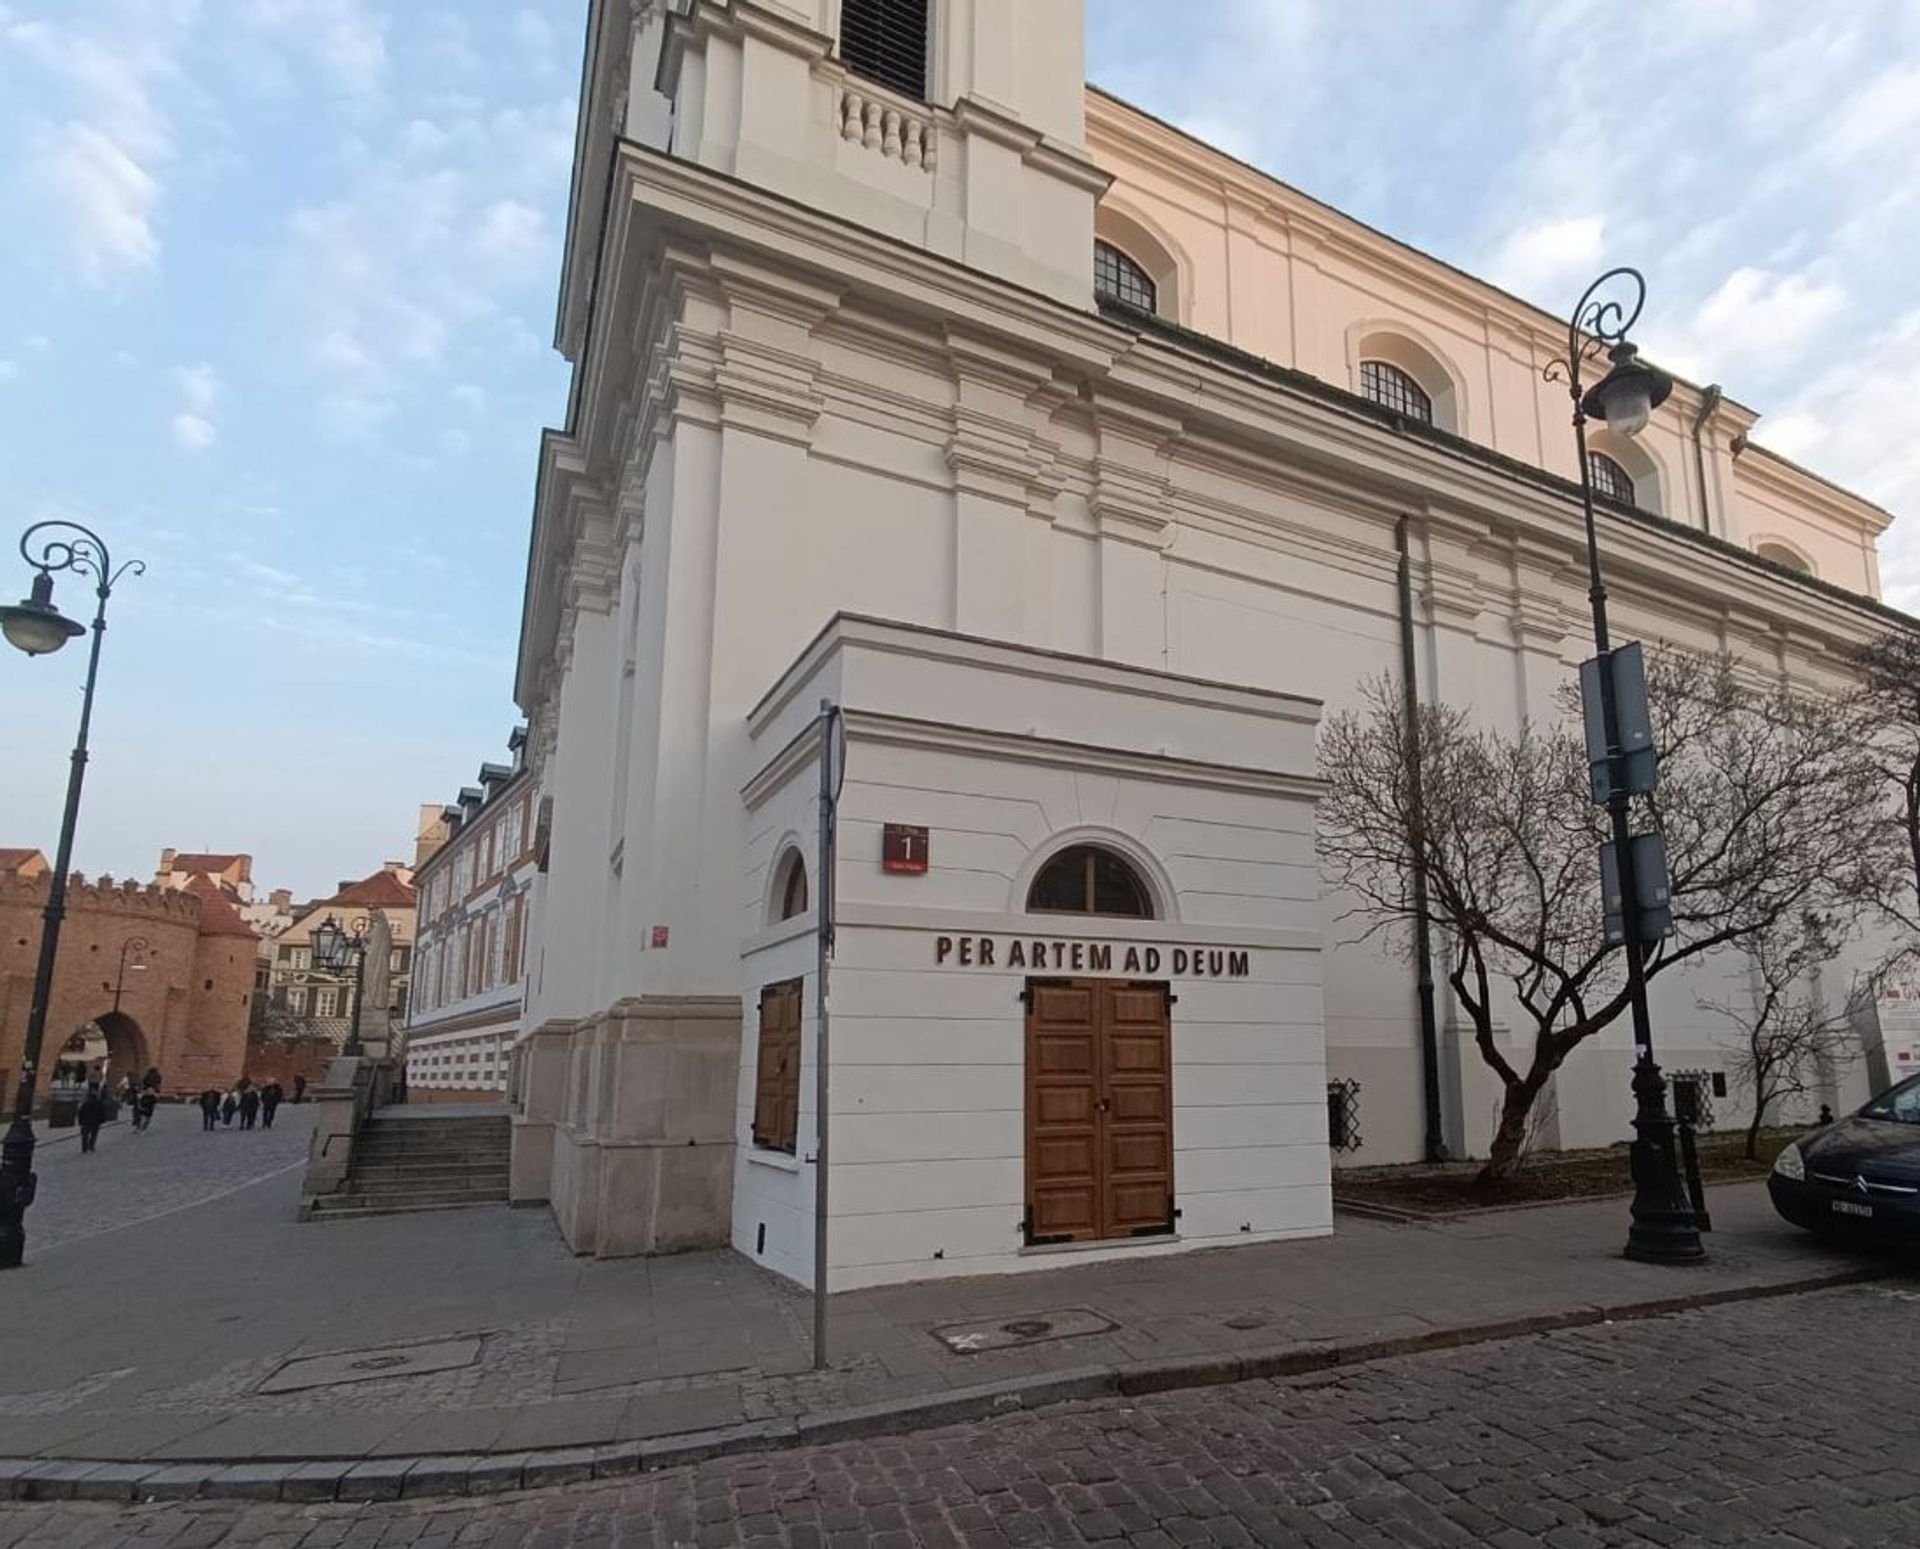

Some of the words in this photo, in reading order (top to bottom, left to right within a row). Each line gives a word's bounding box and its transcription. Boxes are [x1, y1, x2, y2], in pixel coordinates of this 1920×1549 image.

[901, 836, 911, 860] 1
[936, 936, 995, 965] PER
[1007, 940, 1112, 970] ARTEM
[1124, 945, 1161, 973] AD
[1172, 948, 1249, 977] DEUM
